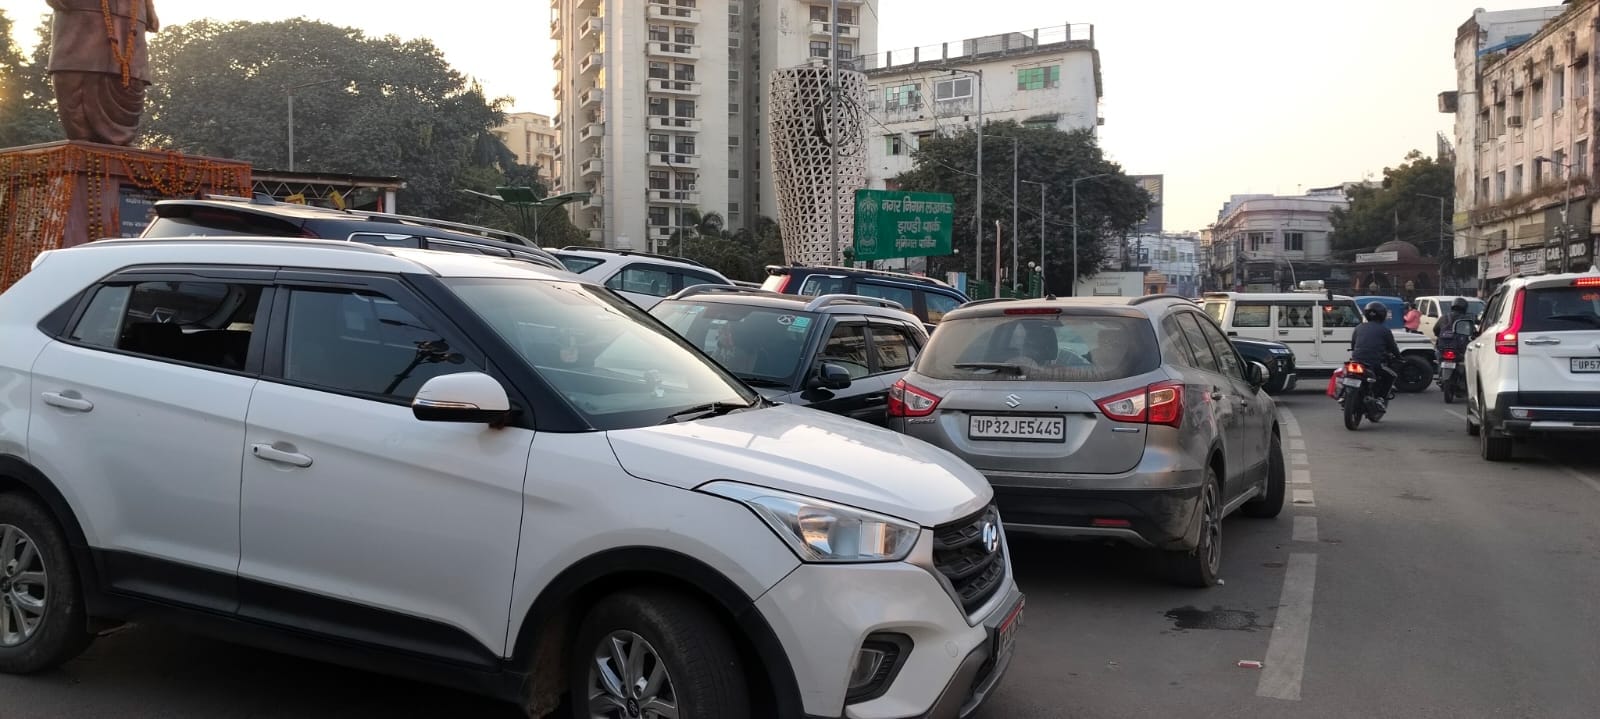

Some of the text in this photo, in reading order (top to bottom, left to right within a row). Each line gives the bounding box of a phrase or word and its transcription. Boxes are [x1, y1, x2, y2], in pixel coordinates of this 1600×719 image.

[882, 196, 952, 214] नगर निगम लखनऊ
[923, 217, 941, 232] पार्क
[1546, 247, 1560, 261] CAR
[977, 420, 1061, 435] UP32JE5445
